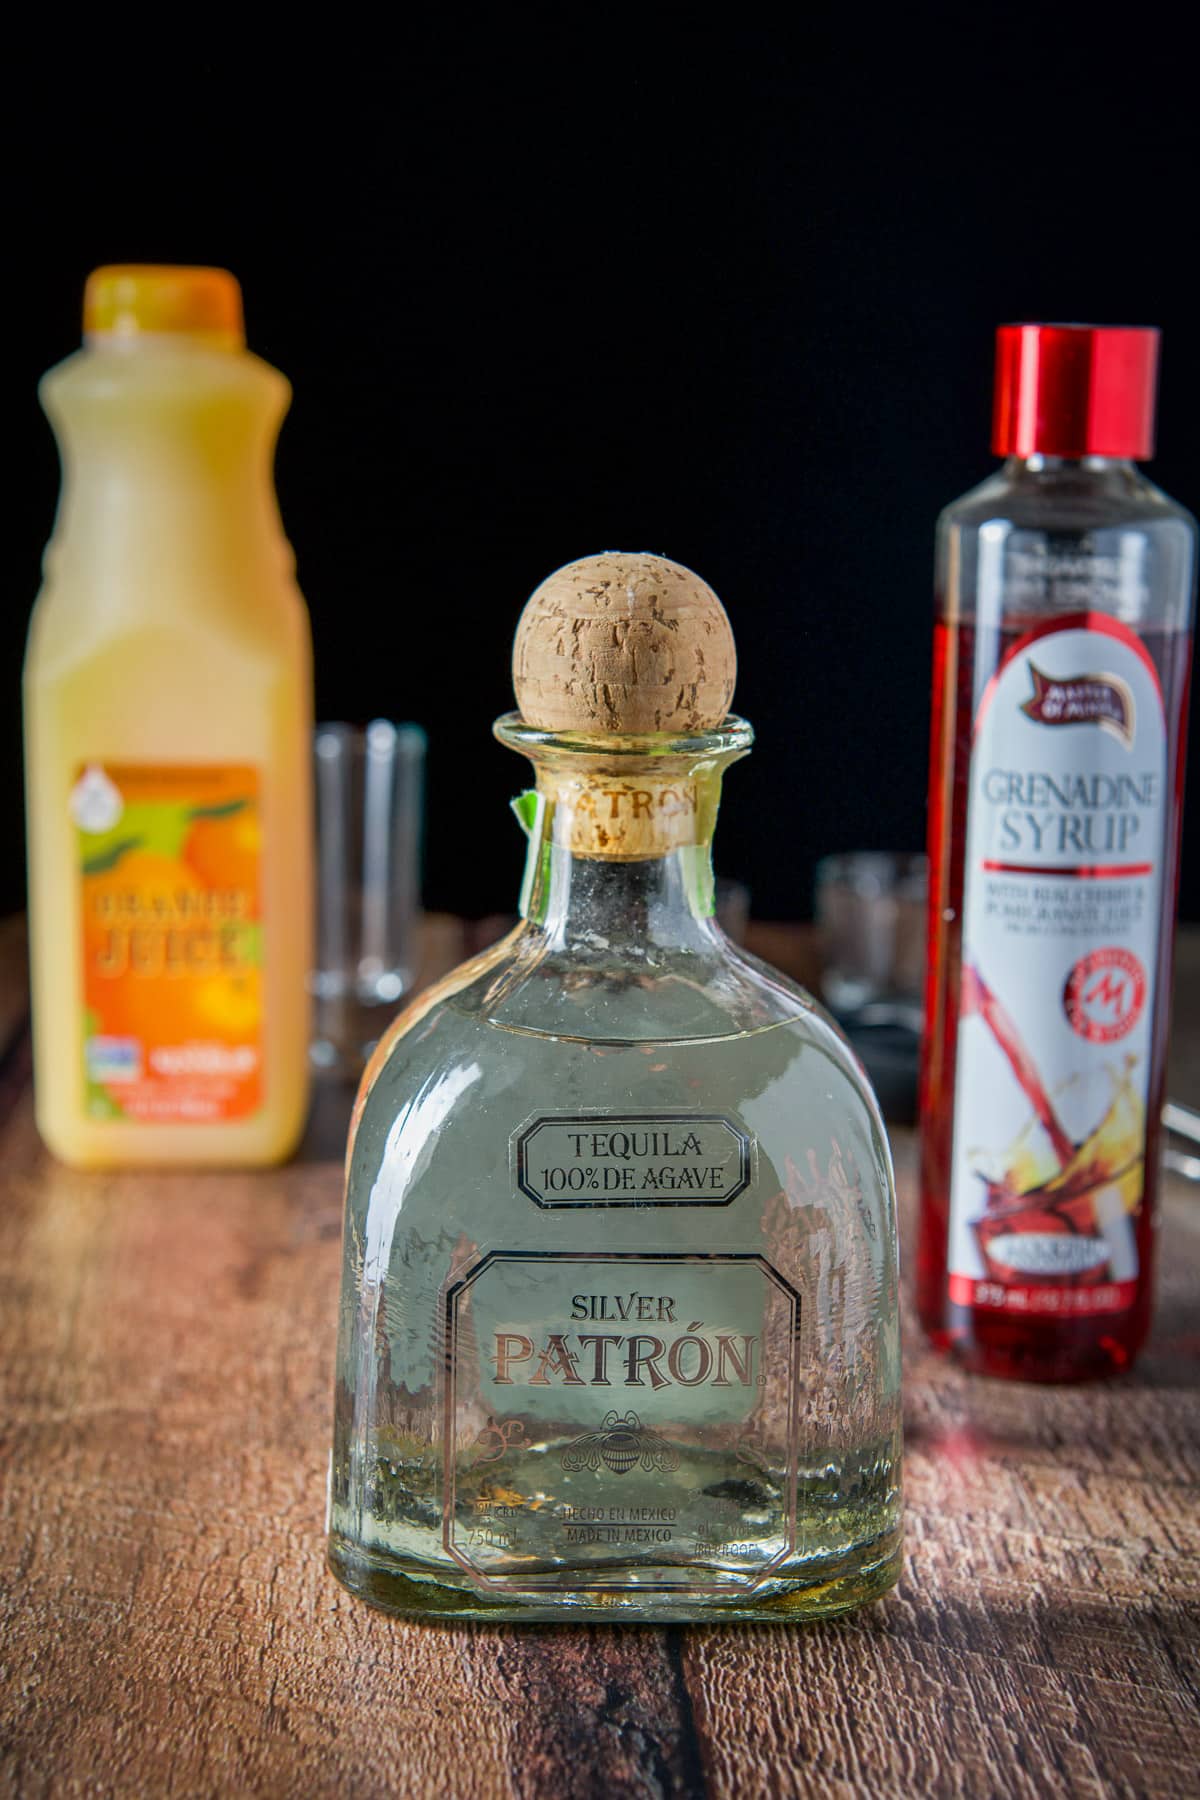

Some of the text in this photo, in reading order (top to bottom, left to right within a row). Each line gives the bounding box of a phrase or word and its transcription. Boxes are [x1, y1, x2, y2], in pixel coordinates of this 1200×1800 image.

[981, 768, 1155, 810] GRENADINE
[1001, 810, 1140, 852] SYRUP
[568, 1133, 703, 1160] TEQUILA
[541, 1167, 725, 1191] 100% DE AGAVE
[570, 1292, 679, 1323] SILVER
[489, 1321, 759, 1391] PATRÓN
[609, 1508, 625, 1521] EN
[629, 1508, 677, 1521] MEXICO
[567, 1528, 672, 1542] MADE IN MEXICO
